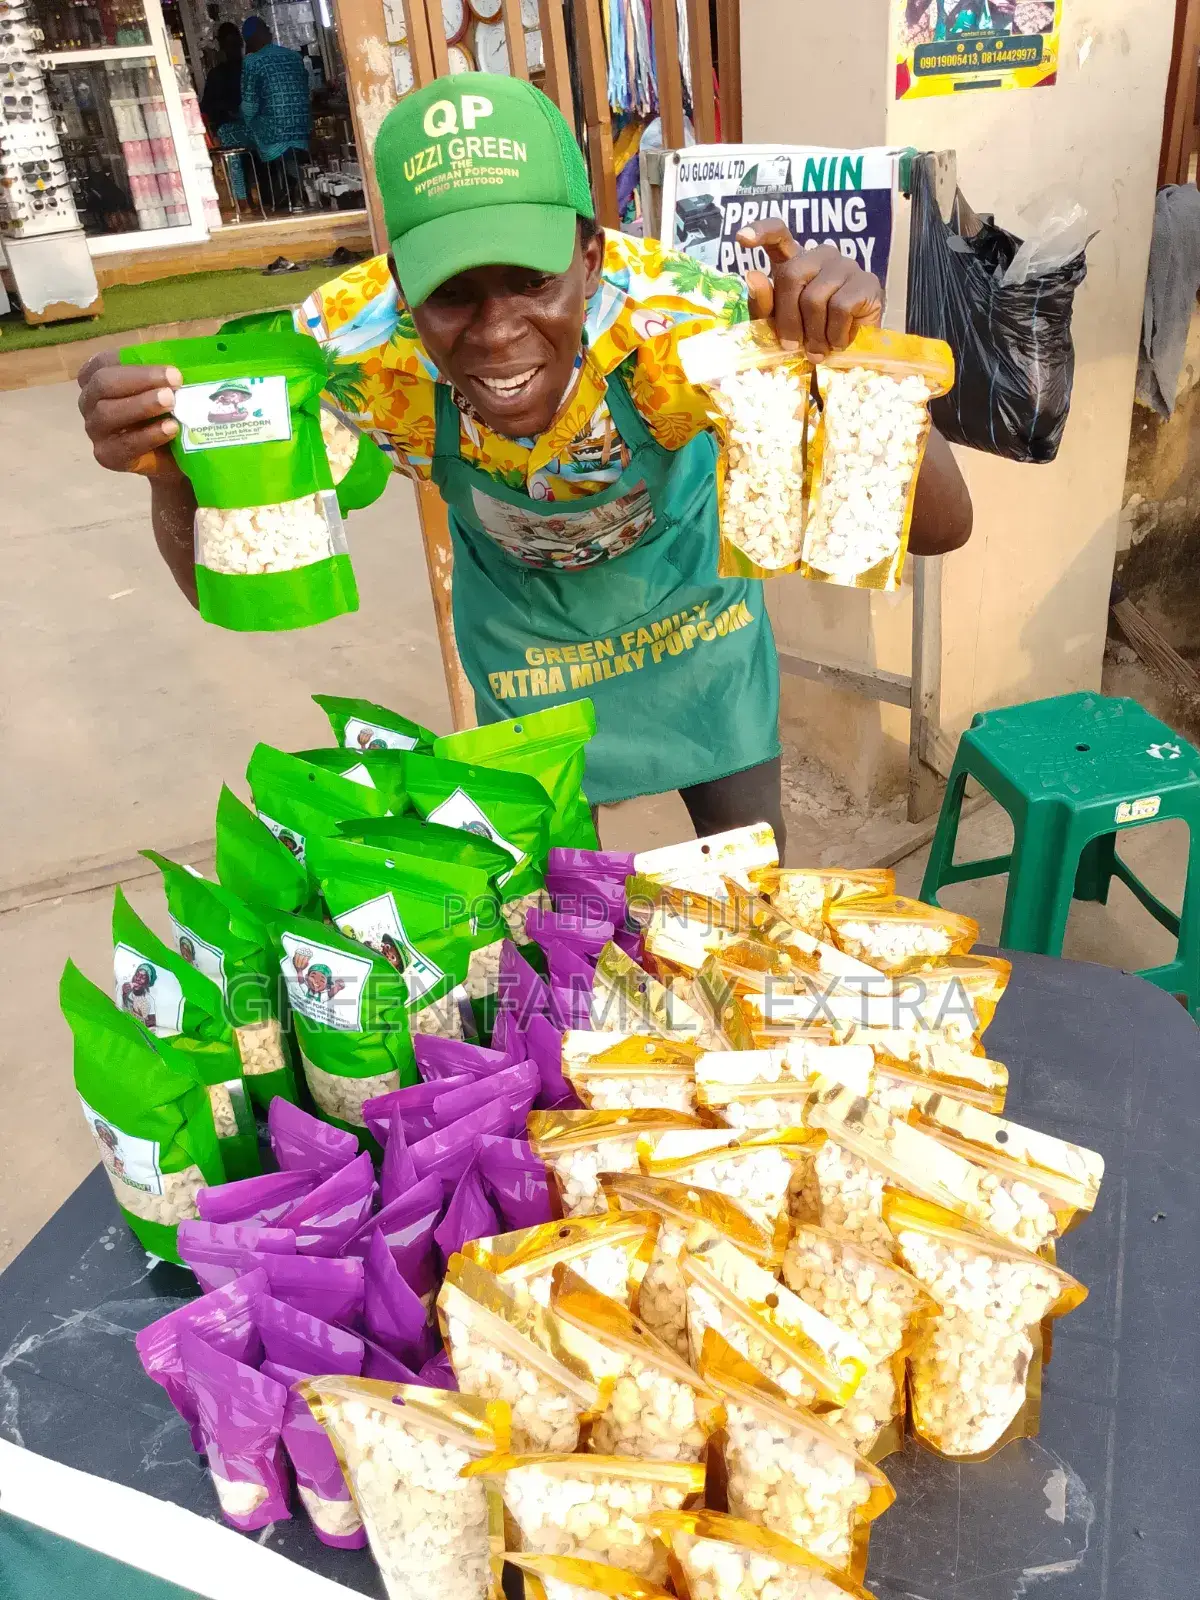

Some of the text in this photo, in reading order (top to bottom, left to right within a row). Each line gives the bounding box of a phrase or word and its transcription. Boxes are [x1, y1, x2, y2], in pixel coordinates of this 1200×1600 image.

[920, 52, 980, 69] 09019005413,
[981, 47, 1037, 64] 08144429973
[423, 94, 493, 138] QP
[404, 136, 527, 181] UZZI GREEN
[450, 159, 473, 170] THE
[680, 160, 745, 182] OJ GLOBAL LTD
[802, 155, 864, 192] NIN
[415, 167, 519, 195] HYPEMAN POPCORN
[723, 196, 868, 236] PRINTING
[191, 420, 271, 433] POPPING POPCORN
[488, 599, 754, 700] EXTRA MILKY POPCORN
[525, 600, 710, 667] GREEN FAMILY
